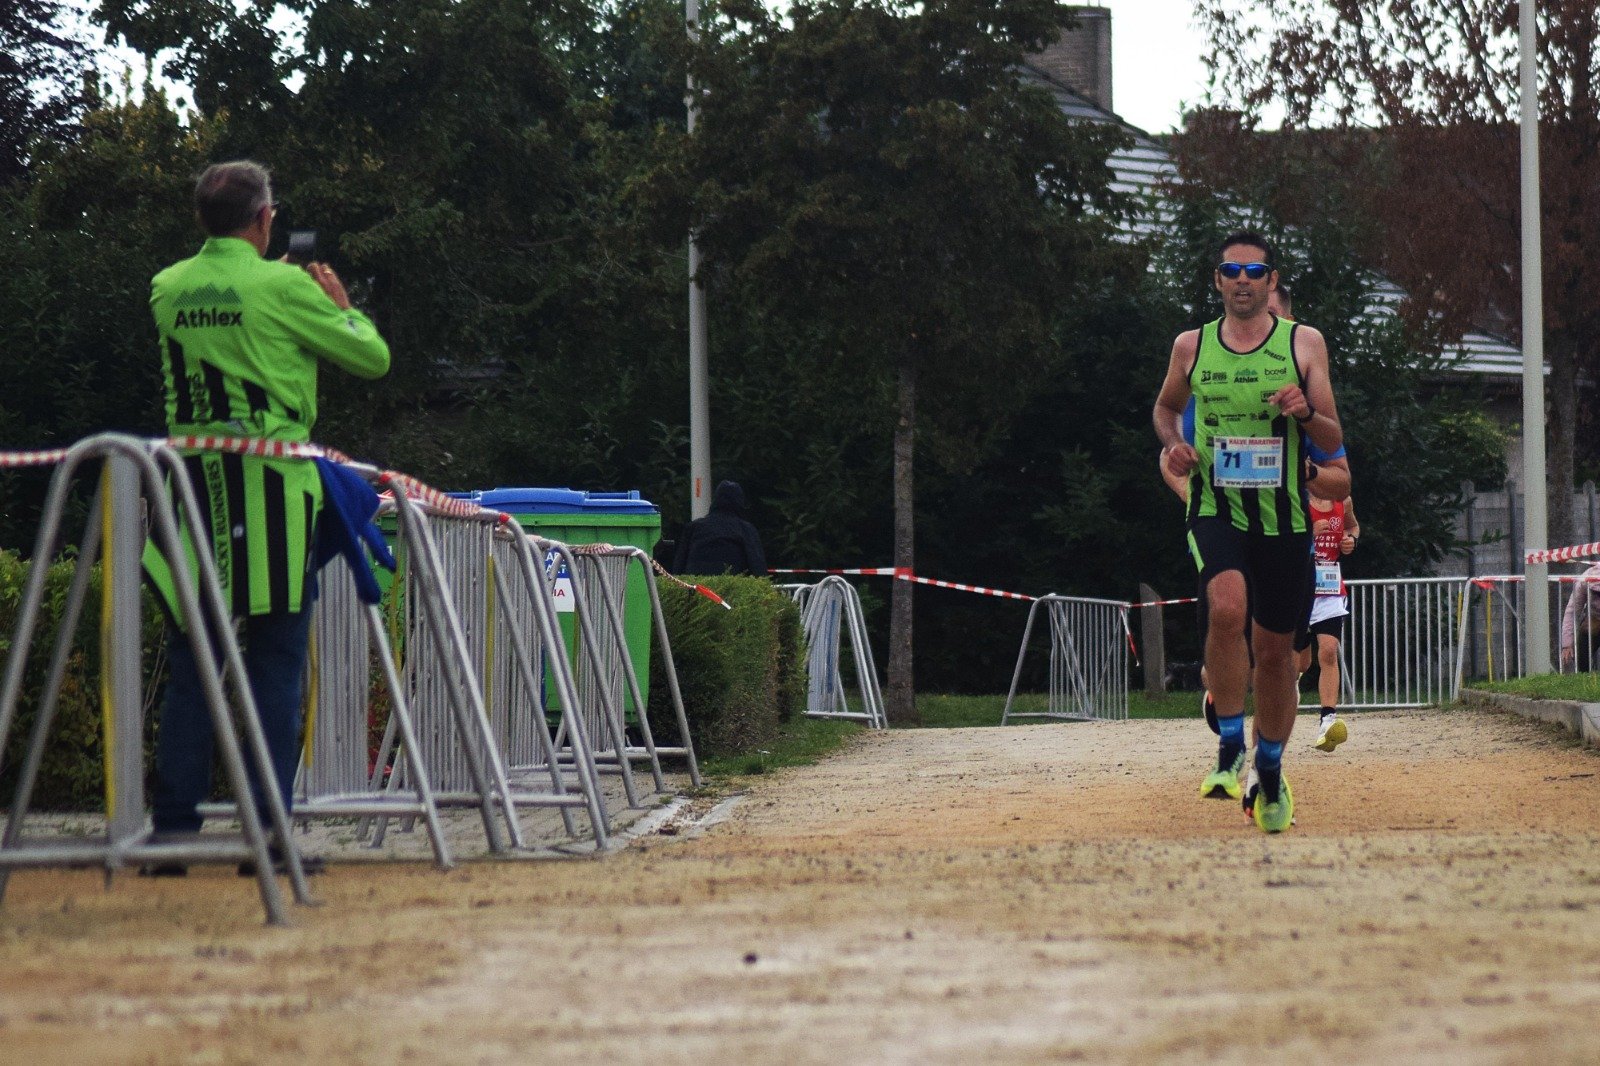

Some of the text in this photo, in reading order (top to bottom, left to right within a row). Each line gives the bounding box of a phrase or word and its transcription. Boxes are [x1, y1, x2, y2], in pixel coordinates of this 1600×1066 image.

[174, 308, 242, 329] Athlex
[1223, 452, 1240, 468] 71
[206, 460, 229, 589] LUCKY RUNNERS
